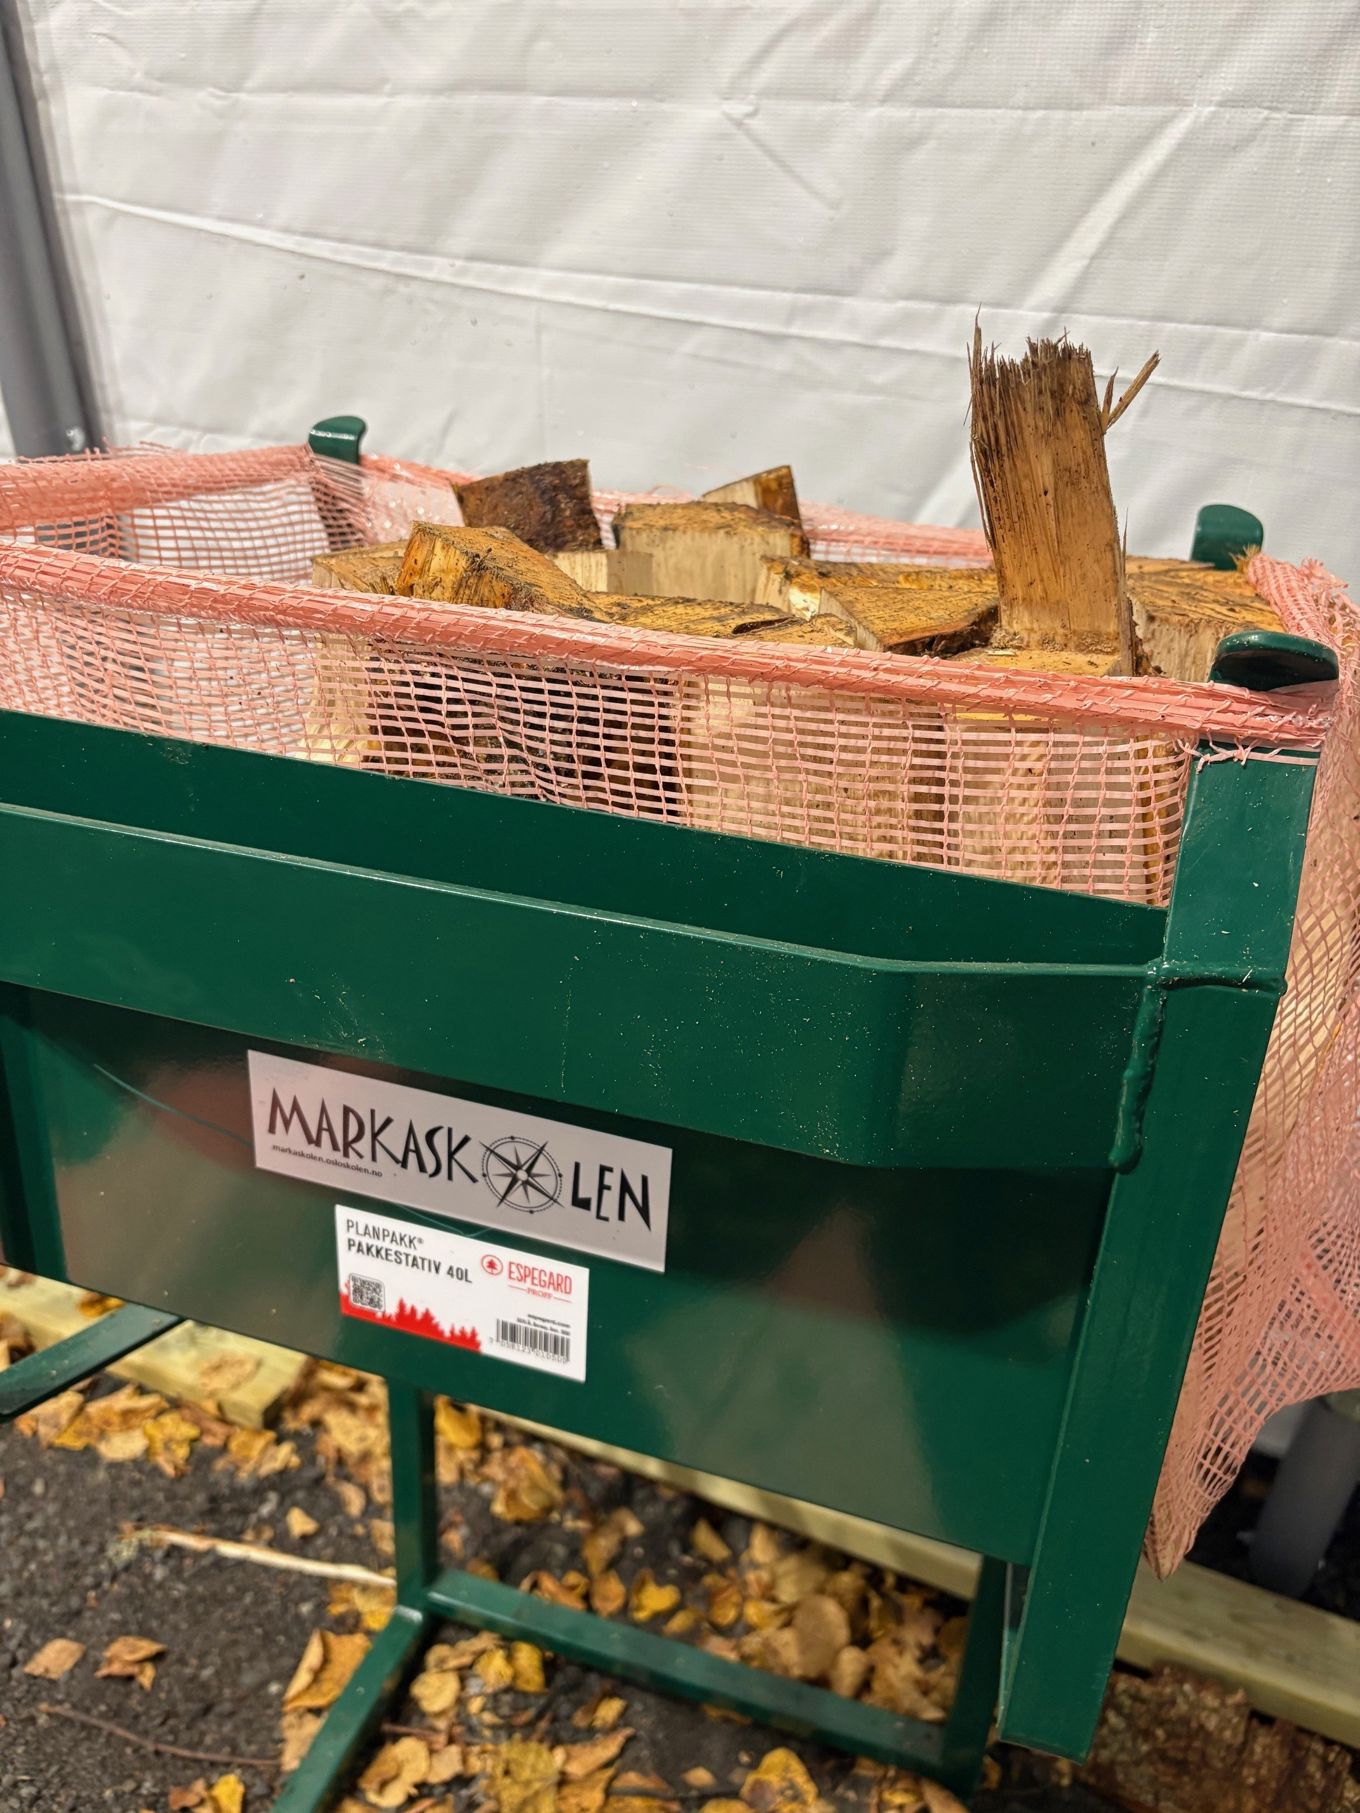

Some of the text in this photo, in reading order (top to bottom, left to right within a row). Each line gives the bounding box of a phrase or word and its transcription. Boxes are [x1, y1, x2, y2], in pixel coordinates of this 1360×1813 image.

[272, 1144, 384, 1178] markaskolen.osloskolen.no
[347, 1238, 473, 1284] PAKKESTATIV 40L
[508, 1261, 572, 1296] ESPEGARD
